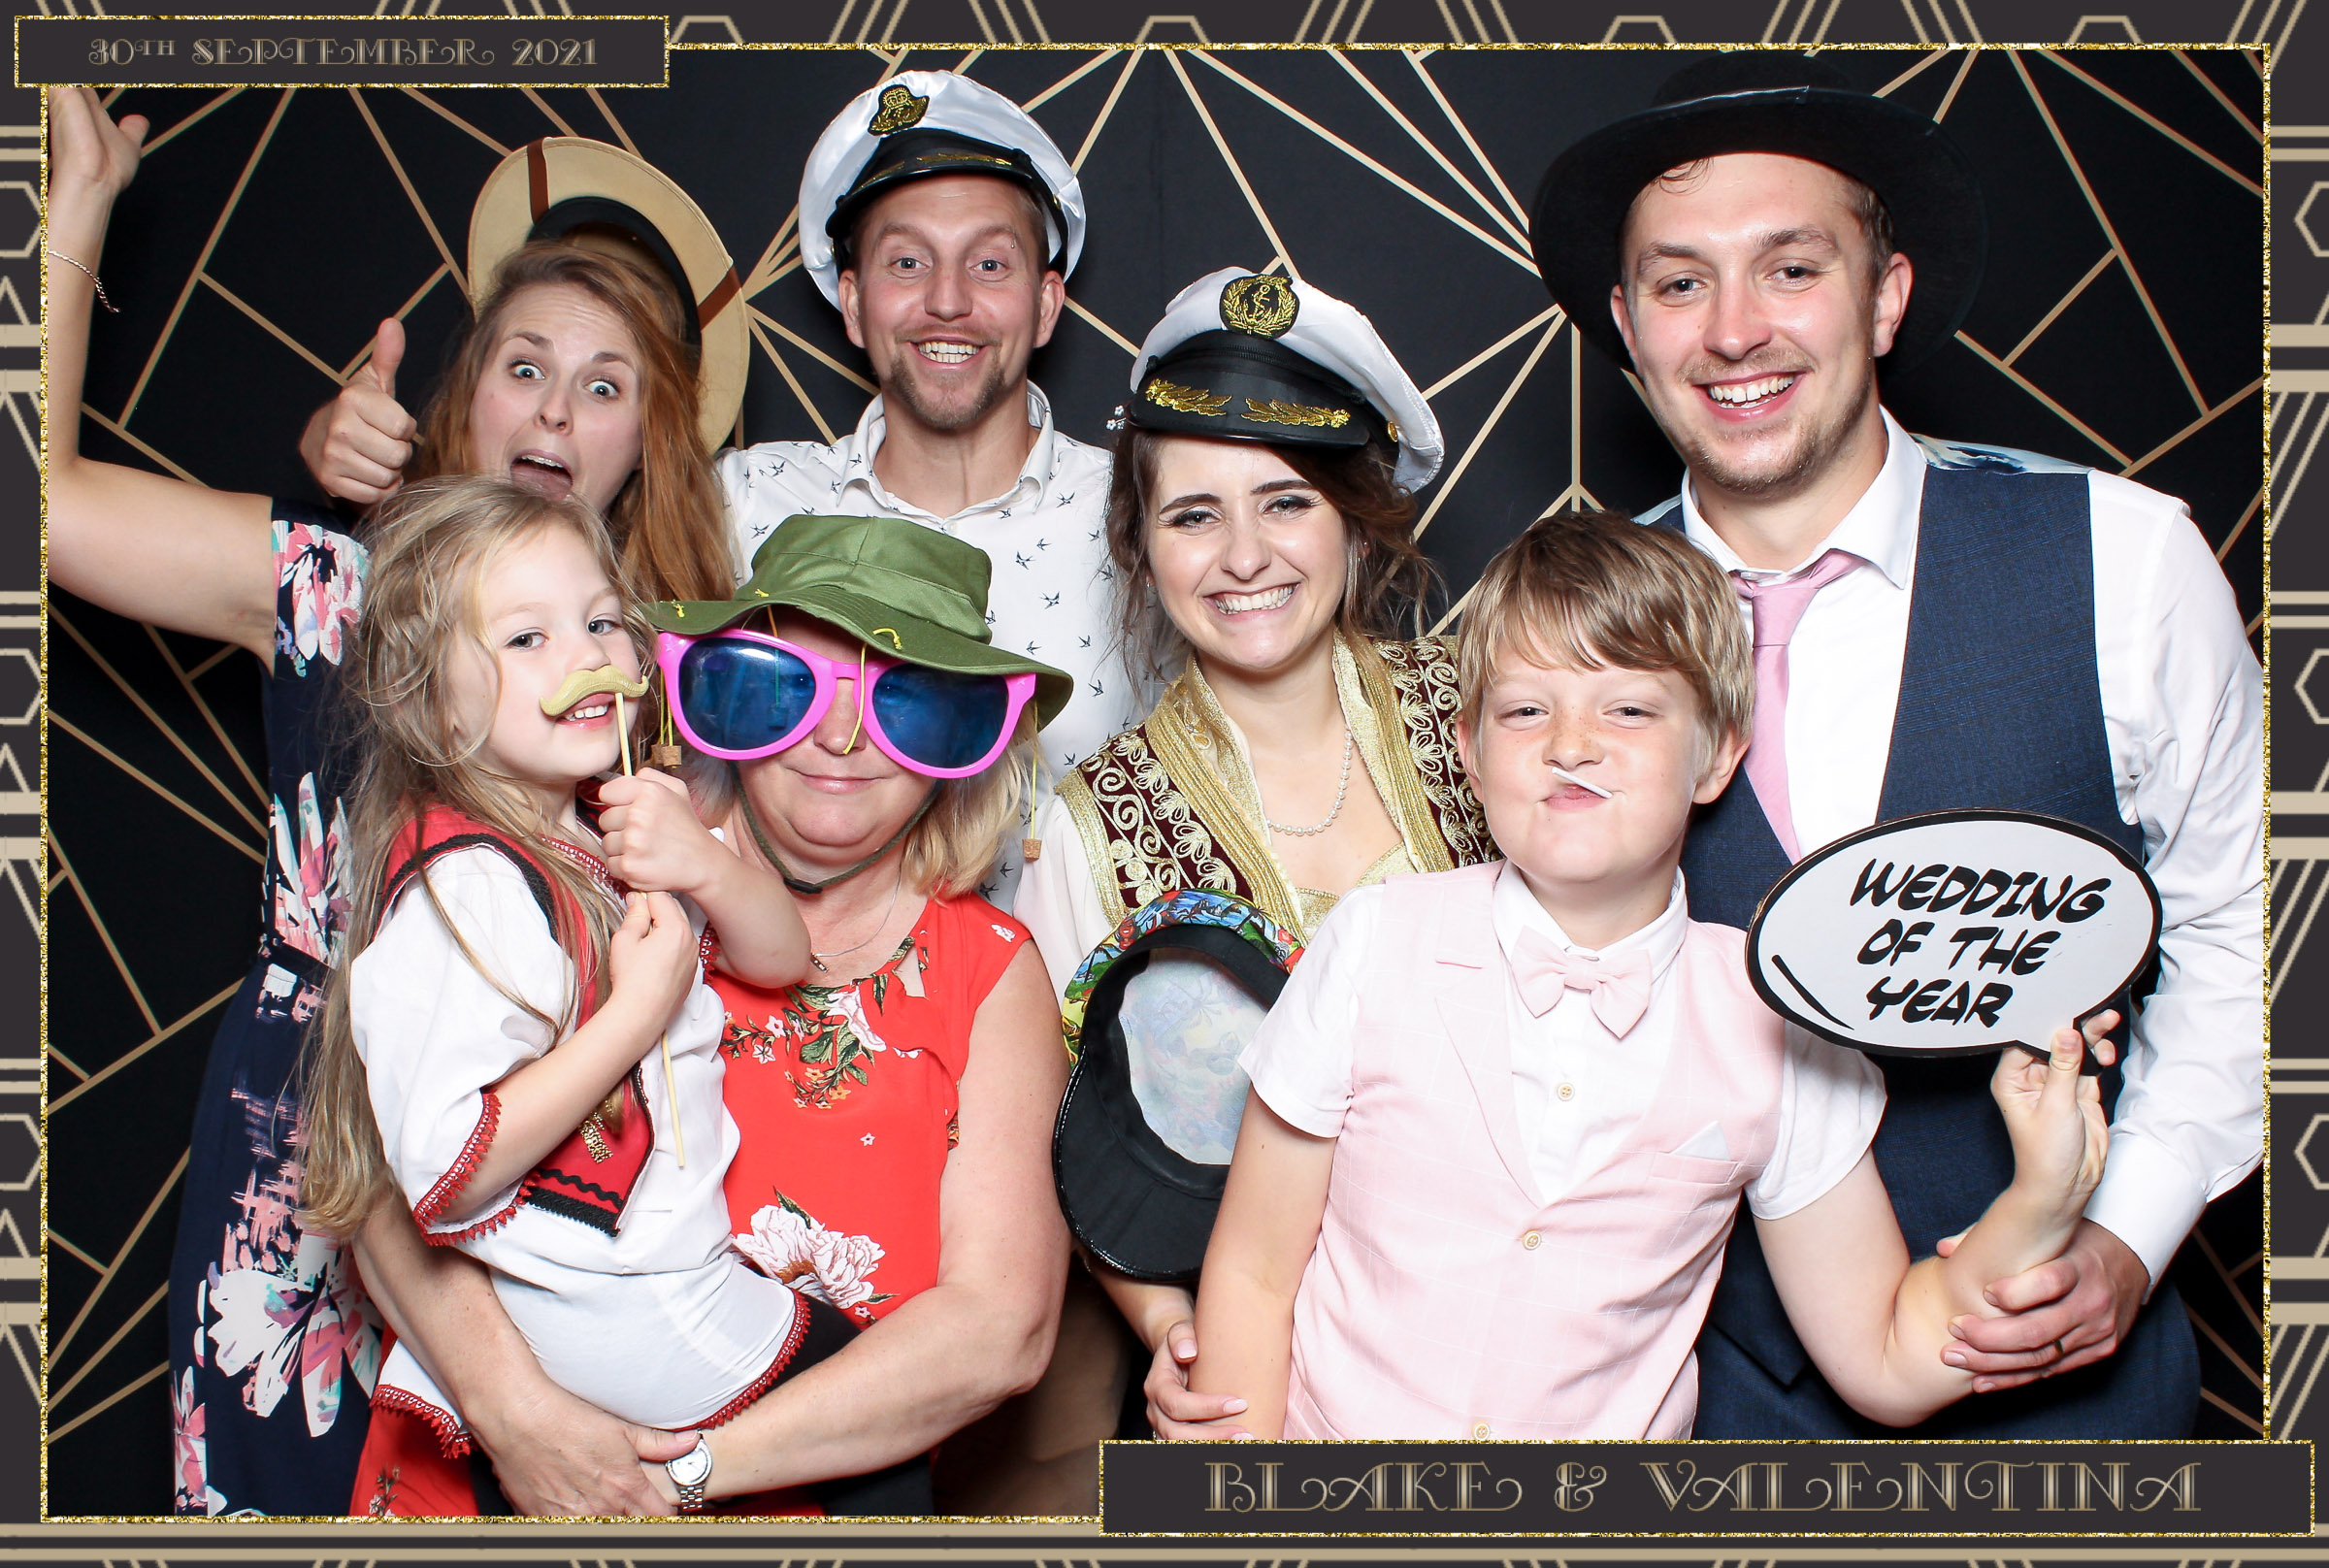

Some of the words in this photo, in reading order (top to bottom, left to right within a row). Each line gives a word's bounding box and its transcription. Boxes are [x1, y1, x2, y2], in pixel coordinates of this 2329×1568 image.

[1850, 858, 2112, 923] WEDDING
[1857, 919, 1935, 966] OF
[1949, 926, 2061, 976] THE
[1865, 976, 2014, 1029] YEAR
